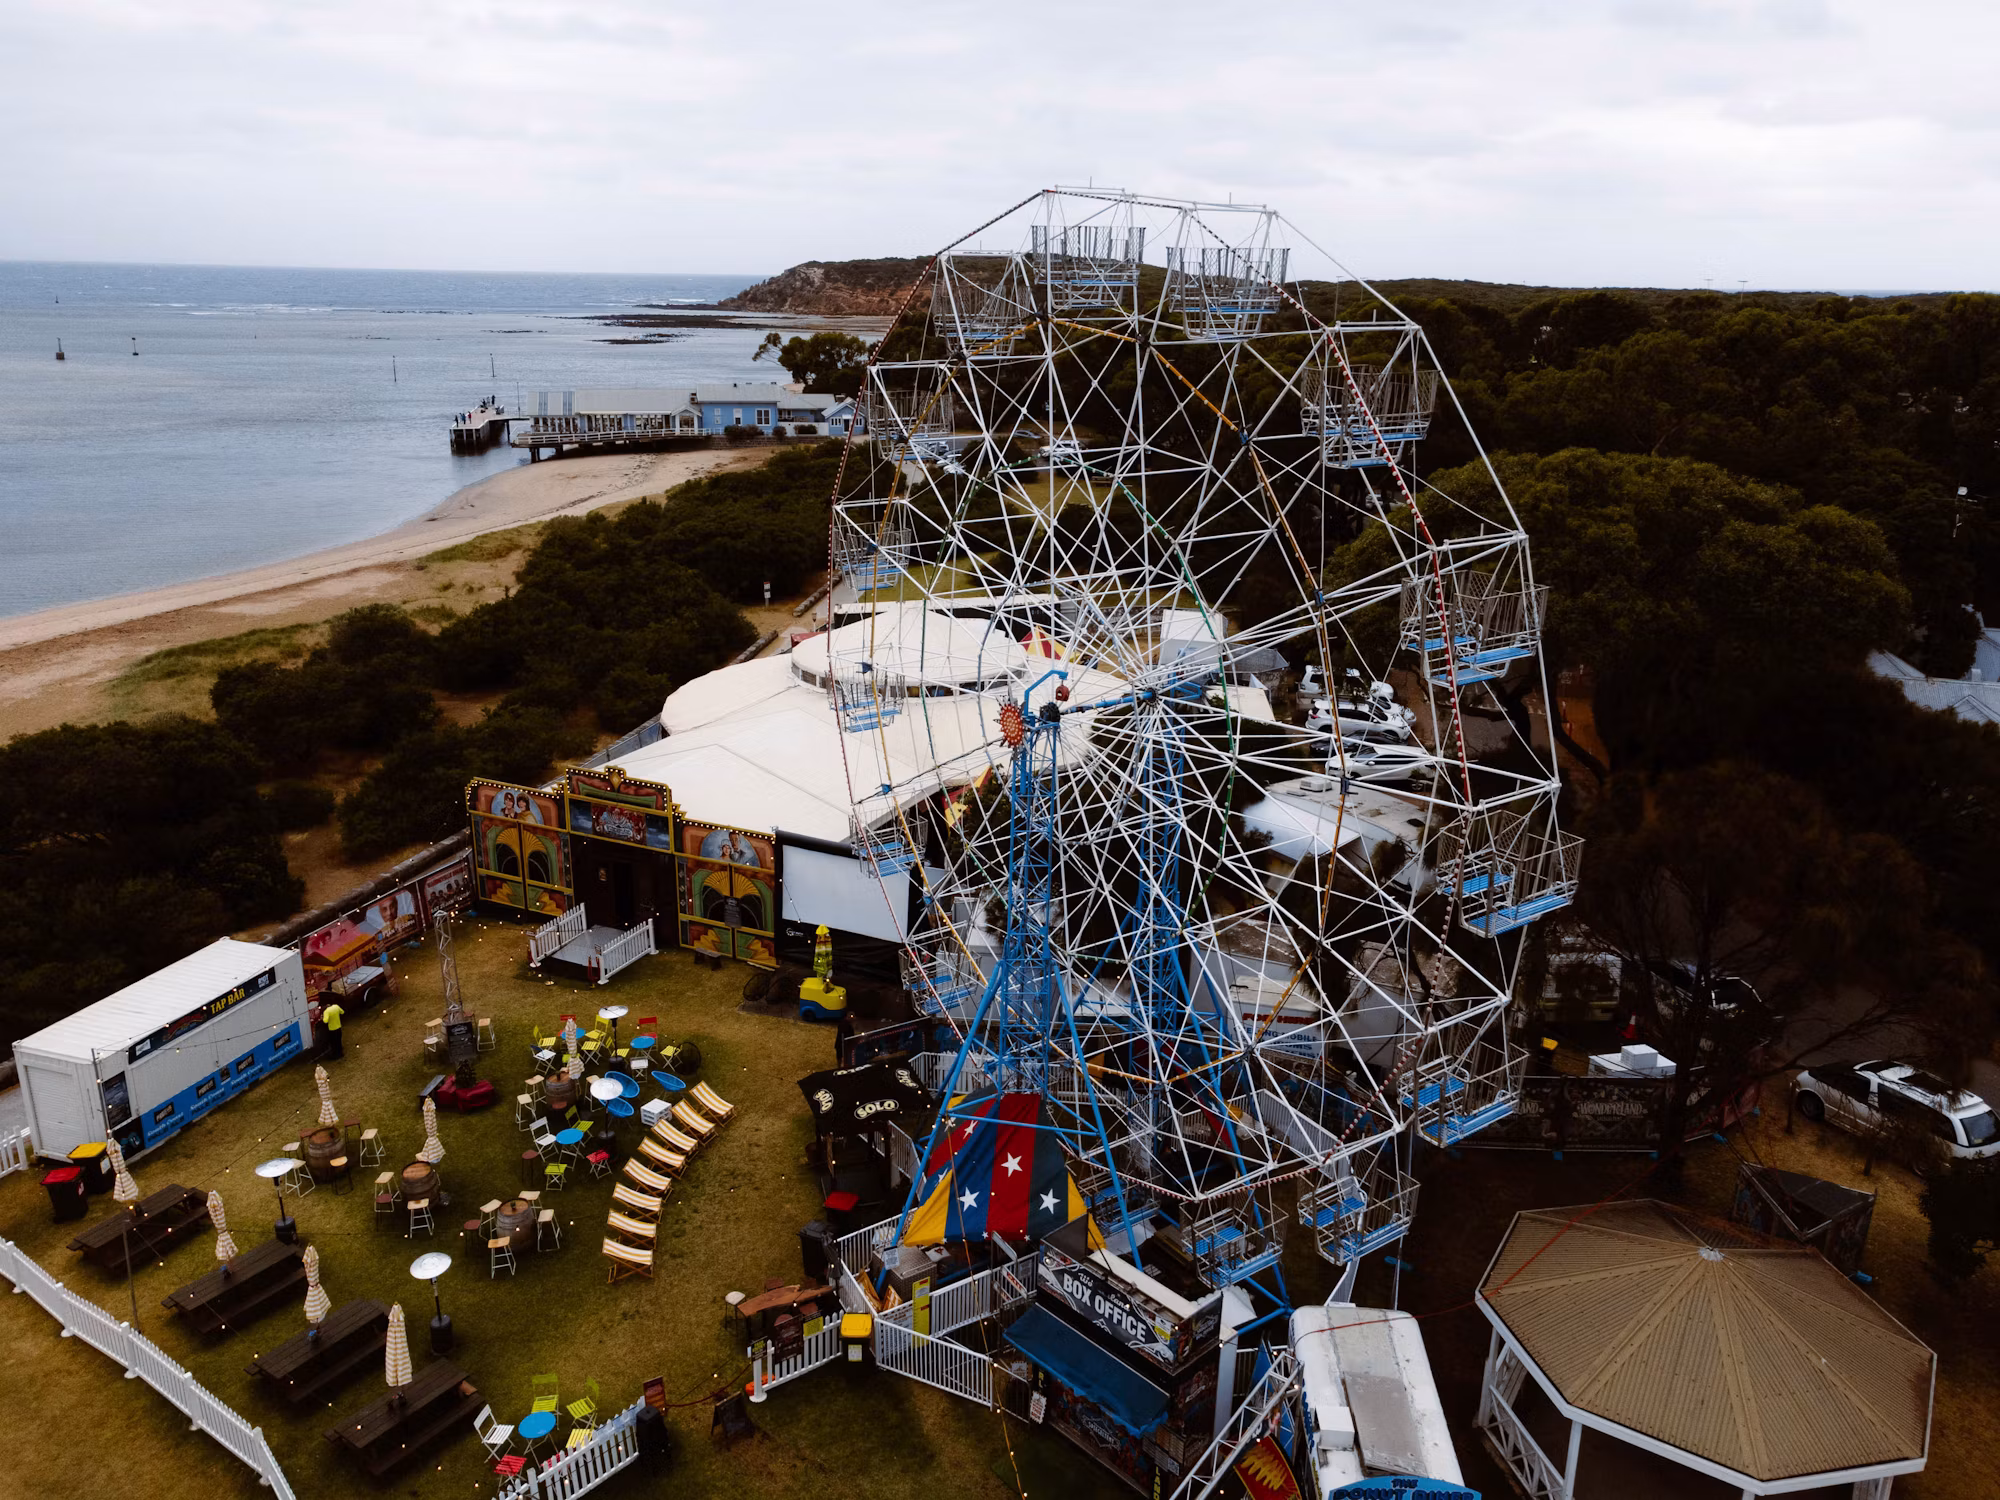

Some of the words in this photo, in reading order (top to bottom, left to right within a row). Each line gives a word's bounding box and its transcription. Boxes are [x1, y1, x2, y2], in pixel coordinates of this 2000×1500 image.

[210, 999, 228, 1015] TAP
[227, 987, 246, 1006] BAR
[815, 1090, 832, 1112] SOLO
[856, 1100, 896, 1118] SOLO
[1580, 1101, 1643, 1116] WONDERLAND
[1062, 1272, 1091, 1307] BOX
[1094, 1296, 1147, 1343] OFFICE
[1334, 1488, 1407, 1500] DONUT
[1411, 1490, 1475, 1500] DINER
